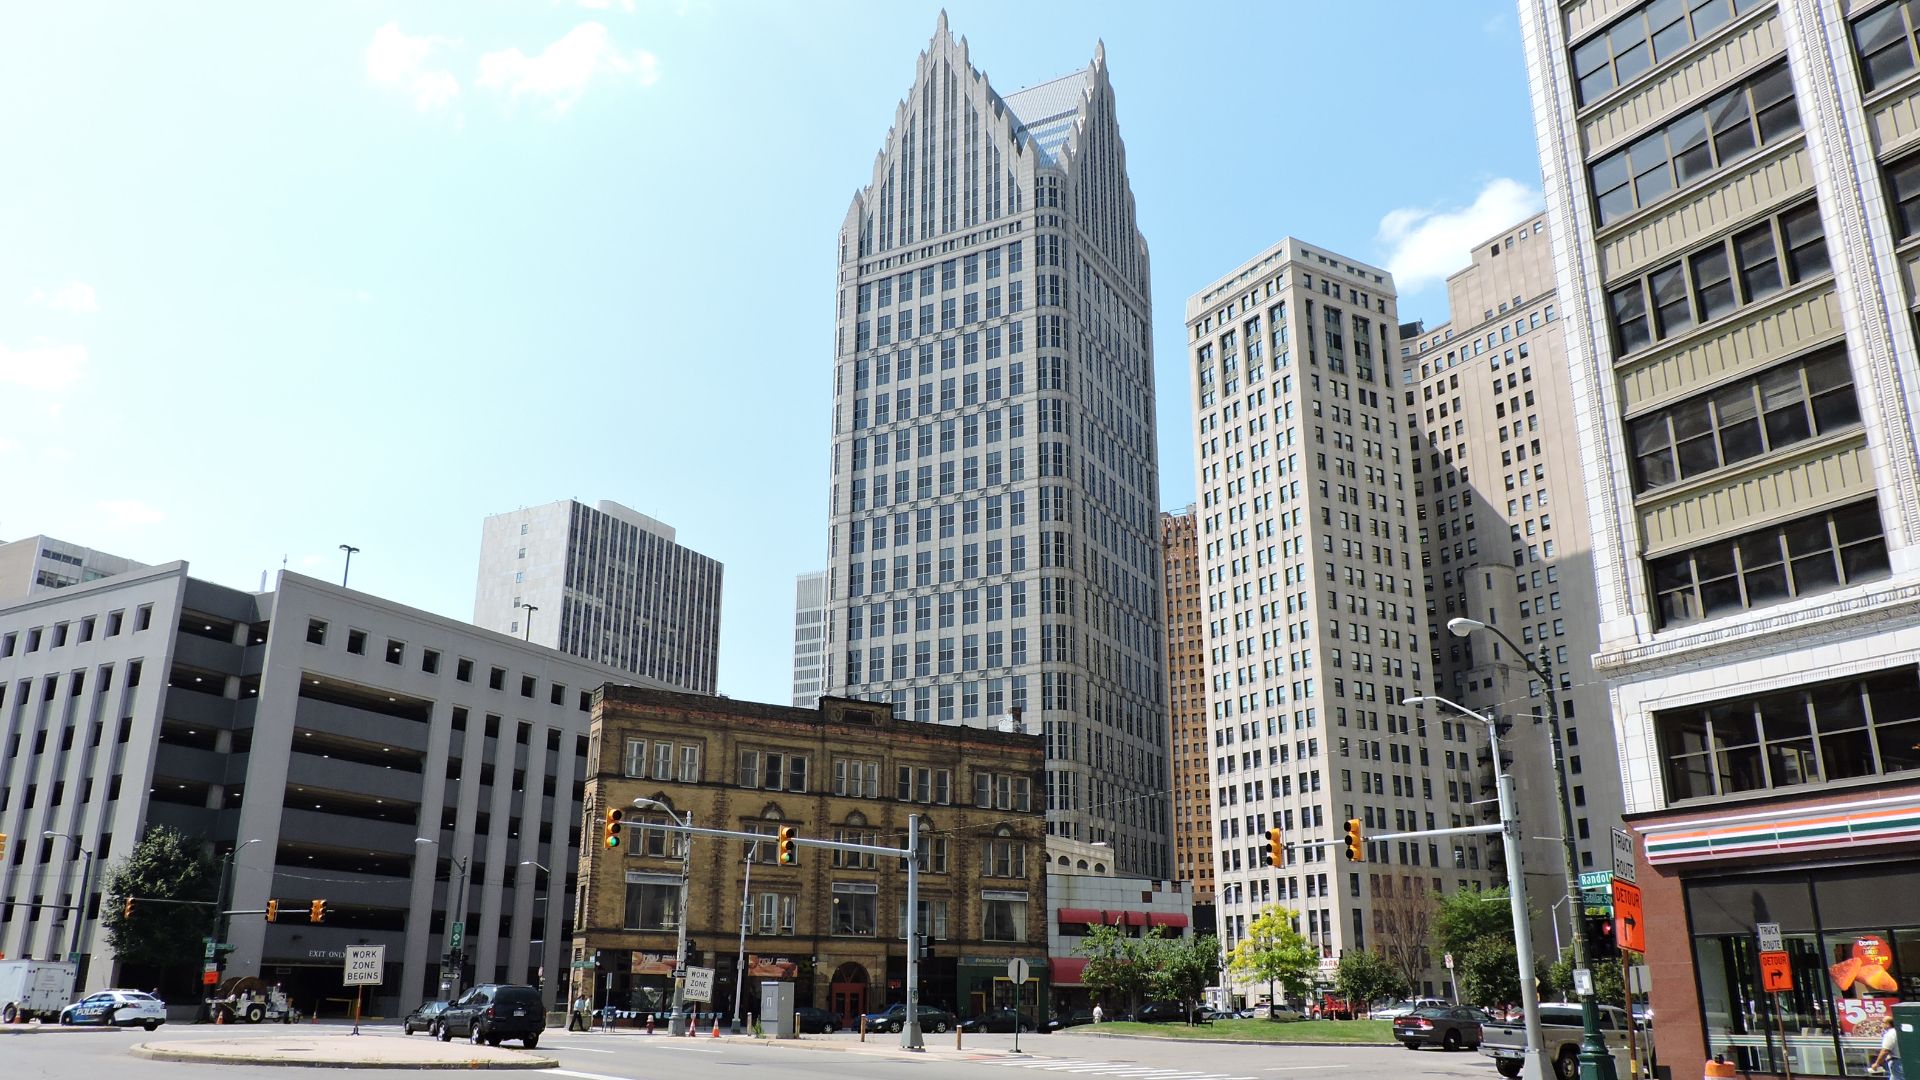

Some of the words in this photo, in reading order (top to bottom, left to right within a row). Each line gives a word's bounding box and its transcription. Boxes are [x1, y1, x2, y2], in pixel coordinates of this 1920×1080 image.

[1614, 833, 1633, 854] TRUCK
[1616, 858, 1634, 879] ROUTE
[1616, 887, 1640, 907] DETOUR
[1760, 926, 1778, 934] TRUCK
[1763, 940, 1781, 949] ROUTE
[352, 950, 377, 958] WORK
[352, 961, 375, 969] ZONE
[1762, 956, 1786, 966] DETOUR
[347, 972, 378, 980] BEGINS
[691, 971, 709, 979] WORK
[690, 980, 707, 988] ZONE
[686, 988, 709, 998] BEGINS
[76, 1007, 104, 1016] POLICE
